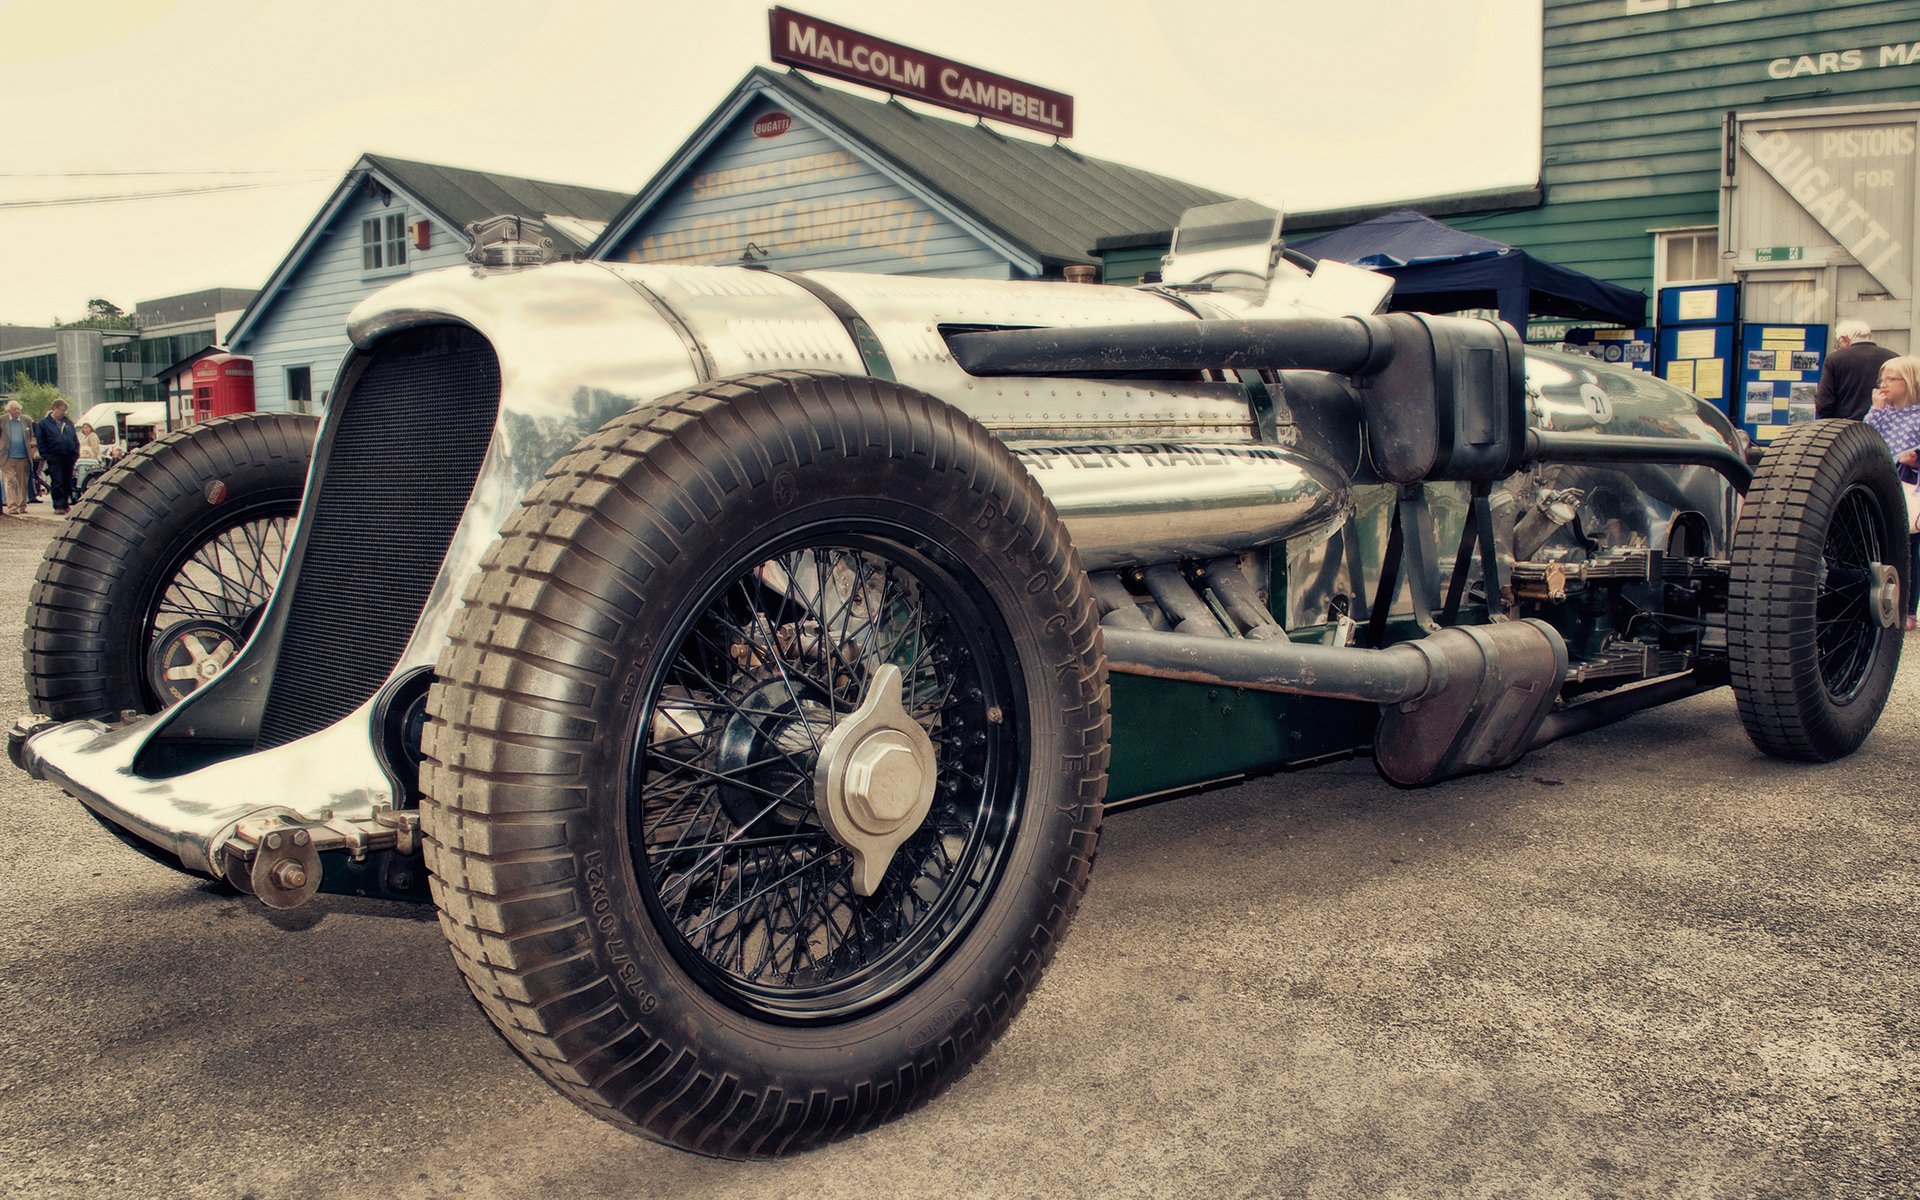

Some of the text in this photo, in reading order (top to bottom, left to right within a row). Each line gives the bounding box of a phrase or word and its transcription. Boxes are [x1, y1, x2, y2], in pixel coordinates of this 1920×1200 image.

[789, 21, 1063, 128] MALCOLM CAMPBELL
[1768, 49, 1863, 79] CARS
[755, 118, 790, 134] BUGATTI
[1822, 127, 1915, 160] PISTONS
[692, 151, 858, 202] SERVICE DEPOT
[1853, 169, 1896, 189] FOR
[1756, 129, 1901, 276] BUGATTI
[1526, 325, 1566, 339] MEWS
[1590, 396, 1606, 415] 21
